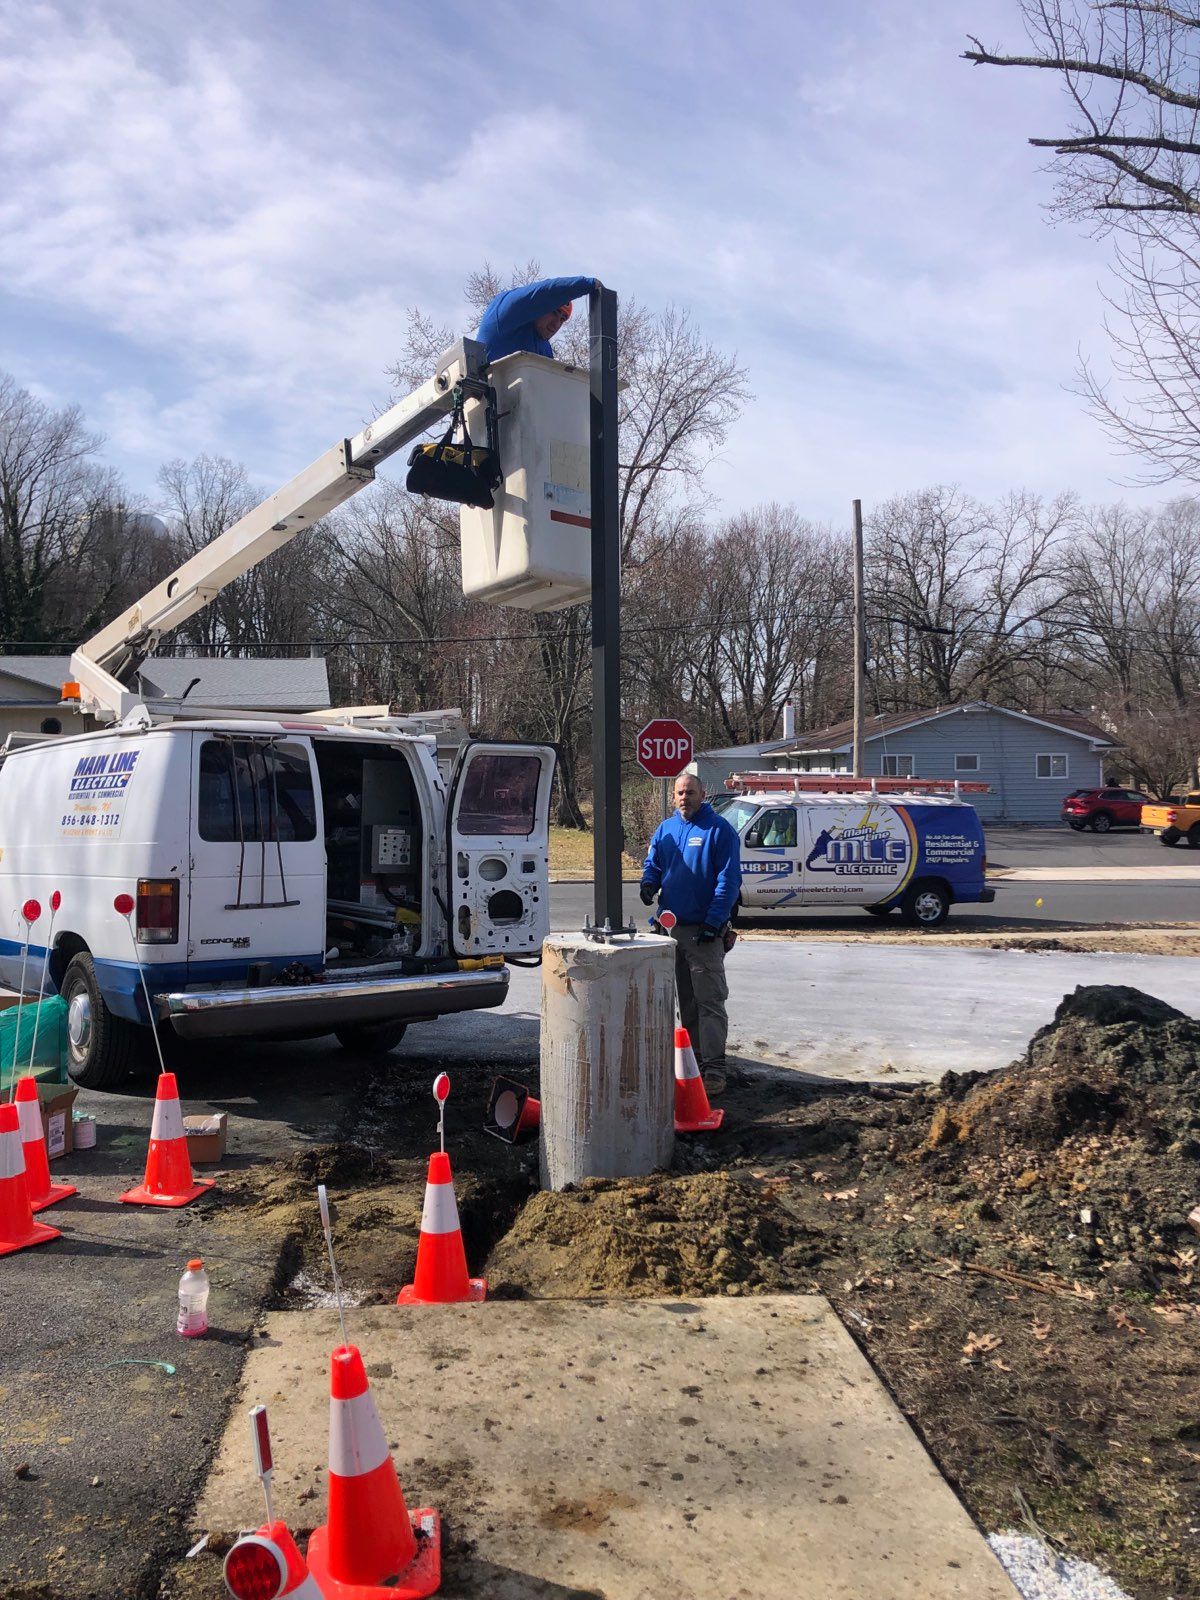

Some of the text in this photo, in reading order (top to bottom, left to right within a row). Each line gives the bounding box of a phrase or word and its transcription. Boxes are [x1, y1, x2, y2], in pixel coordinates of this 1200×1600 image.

[641, 737, 689, 760] STOP
[73, 750, 140, 777] MAIN LINE
[73, 775, 125, 790] ELECTRIC
[61, 814, 120, 826] 856-848-1312
[843, 825, 890, 841] Main Line
[925, 839, 972, 848] Residential
[826, 839, 906, 863] MLE
[925, 847, 975, 856] Commercial
[942, 856, 970, 864] Repairs
[835, 864, 897, 875] ELECTRIC
